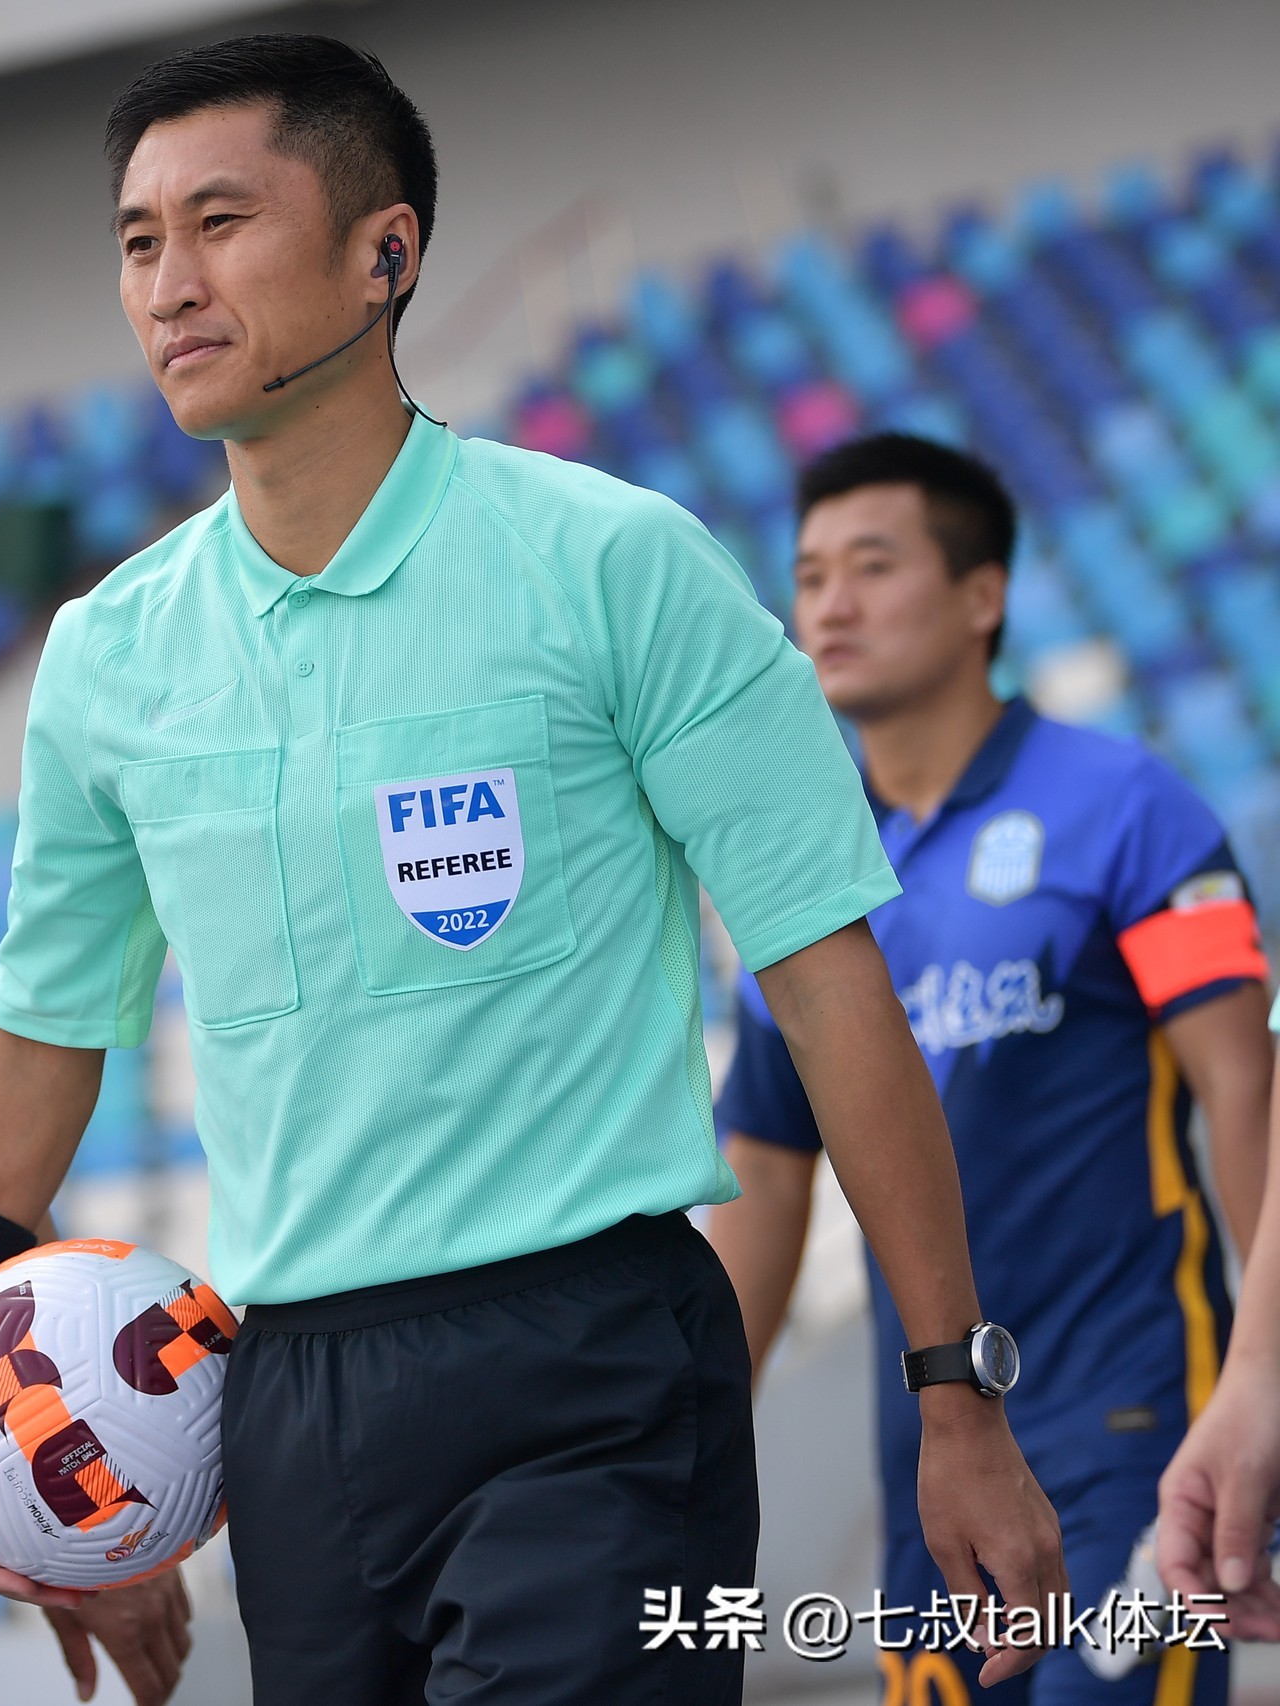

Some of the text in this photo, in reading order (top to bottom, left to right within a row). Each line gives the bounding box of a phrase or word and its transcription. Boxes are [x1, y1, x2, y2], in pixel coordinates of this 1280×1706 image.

[387, 781, 506, 833] FIFA
[397, 848, 513, 883] REFEREE
[436, 909, 490, 934] 2022
[57, 1447, 100, 1476] MATCH BALL
[61, 1440, 96, 1465] OFFICIAL
